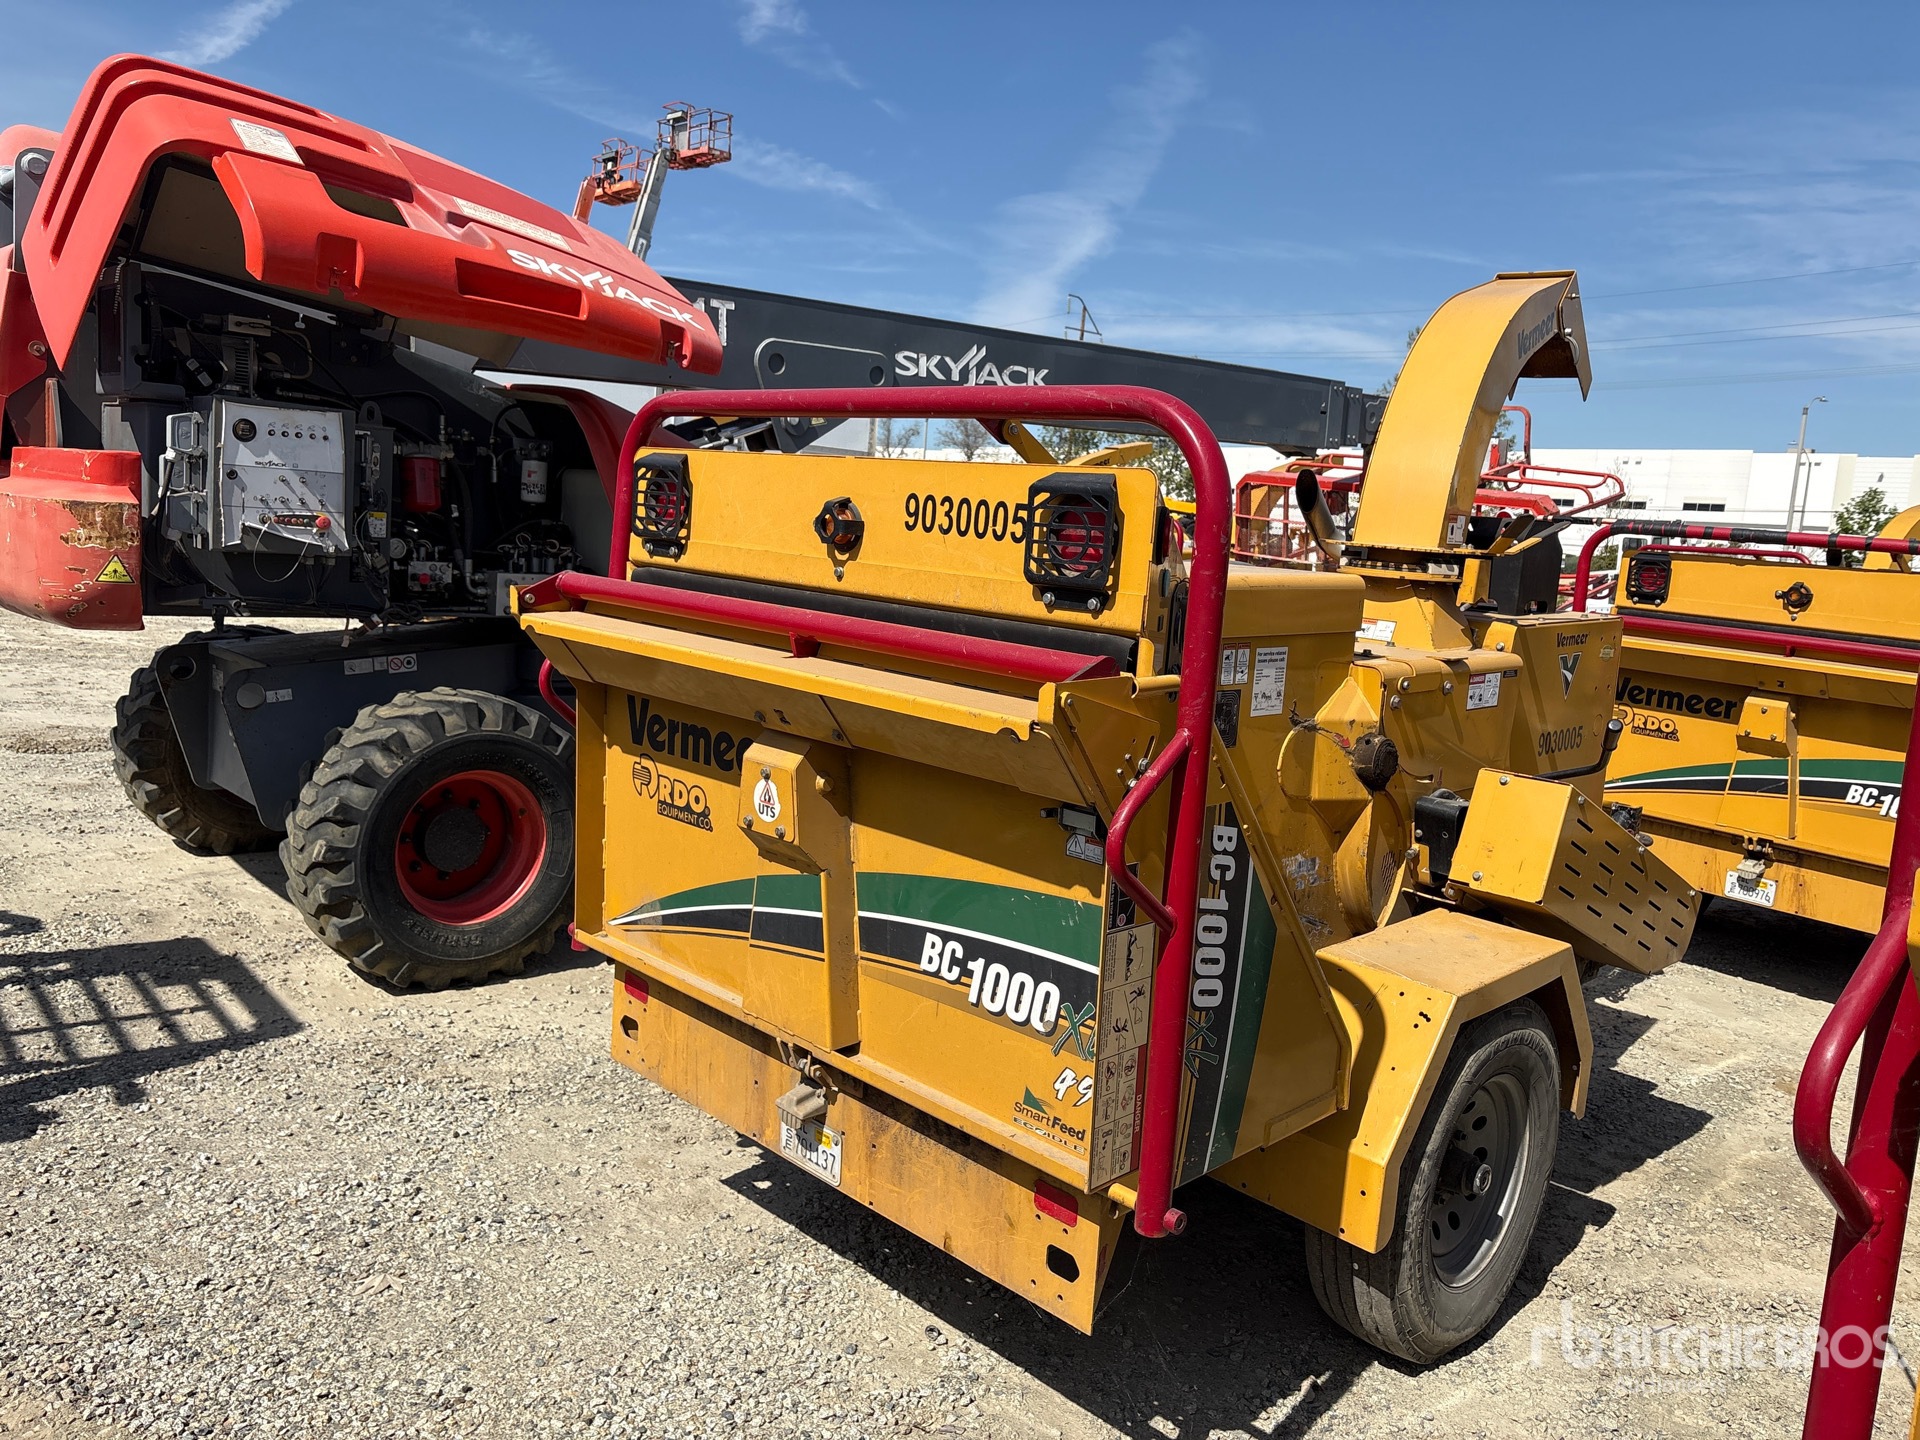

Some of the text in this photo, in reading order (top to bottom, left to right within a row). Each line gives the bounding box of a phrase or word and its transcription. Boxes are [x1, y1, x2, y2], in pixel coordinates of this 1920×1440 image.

[506, 249, 705, 331] SKYJACK
[1518, 311, 1555, 360] Vermeer
[894, 344, 1049, 387] SKYJACK
[904, 492, 1030, 544] 9030005
[1557, 632, 1588, 648] Vermeer
[627, 694, 755, 775] Verme
[1538, 726, 1584, 757] 9030005
[1632, 727, 1667, 739] EQUIPMENT
[658, 803, 698, 825] EQUIPMENT
[758, 802, 776, 819] UTS
[1134, 1093, 1143, 1134] DANGER
